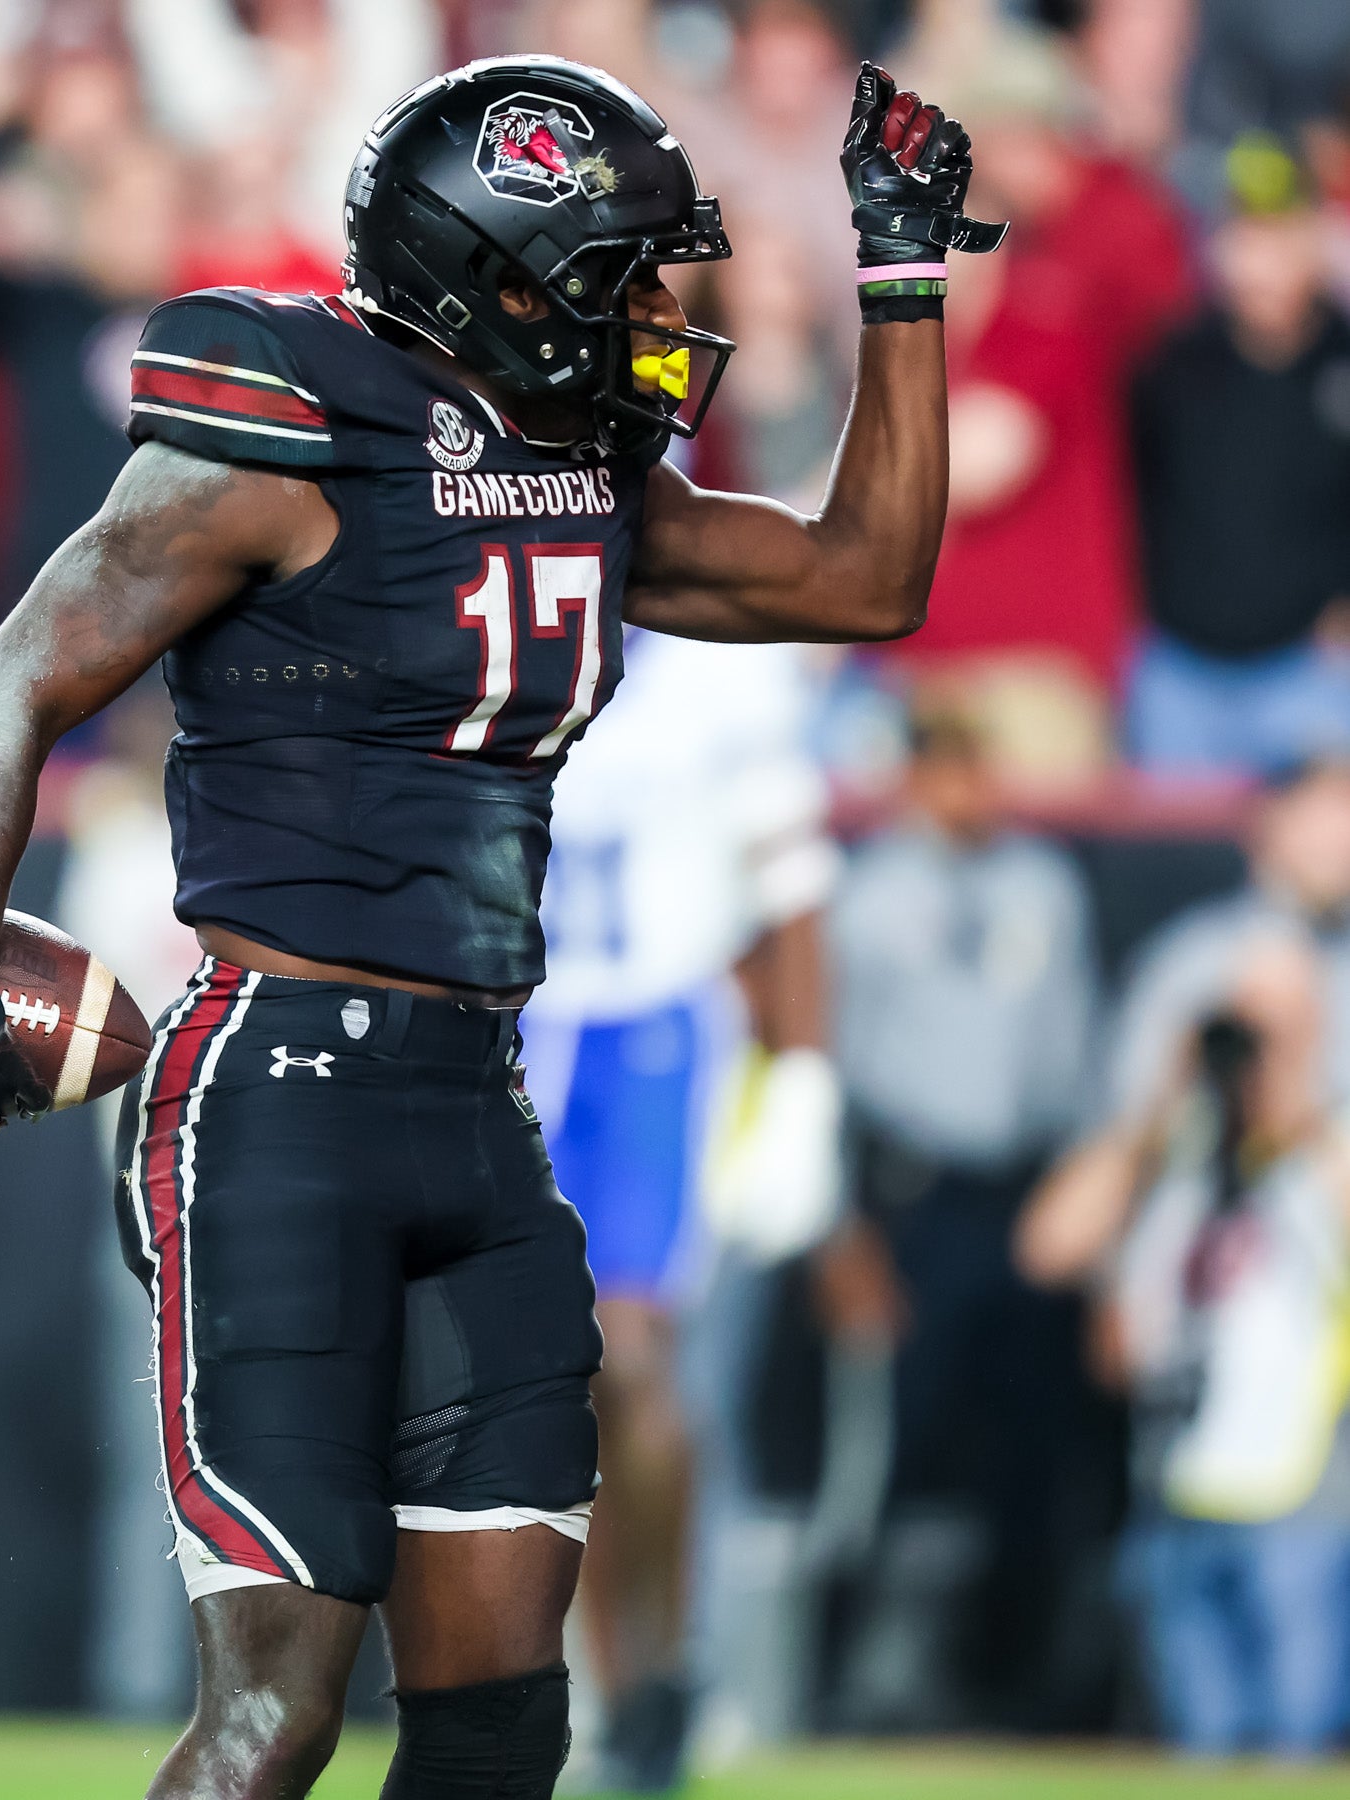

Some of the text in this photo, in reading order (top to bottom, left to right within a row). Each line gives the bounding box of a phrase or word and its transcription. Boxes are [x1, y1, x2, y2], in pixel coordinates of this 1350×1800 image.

[890, 214, 905, 232] UA
[432, 402, 470, 451] SEC
[435, 444, 482, 470] GRADUATE
[432, 466, 615, 517] GAMECOCKS
[444, 542, 604, 762] 17
